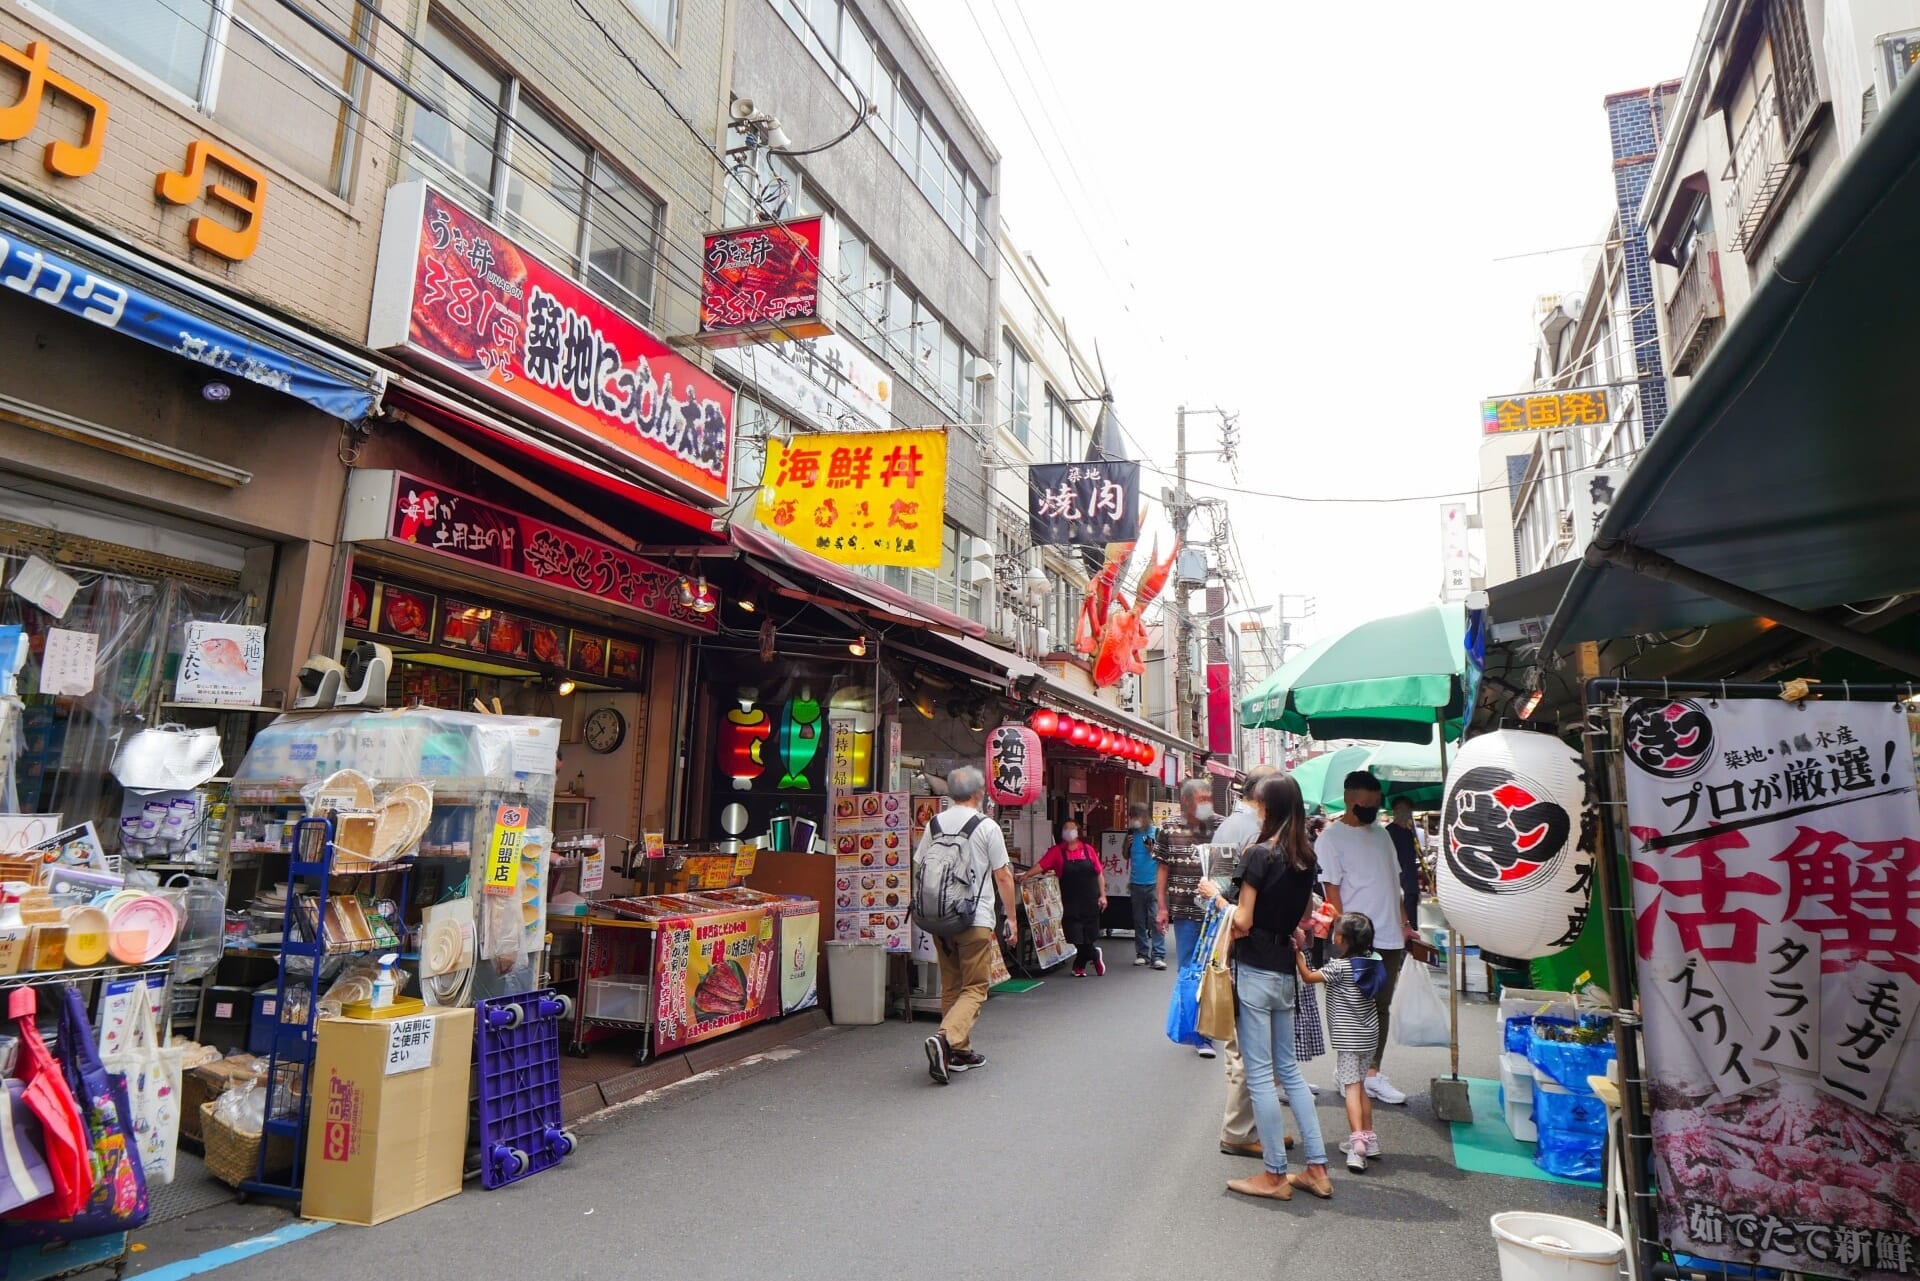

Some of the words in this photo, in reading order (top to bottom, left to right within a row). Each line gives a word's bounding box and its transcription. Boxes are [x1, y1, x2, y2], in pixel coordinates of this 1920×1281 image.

[430, 211, 495, 277] うな丼
[709, 234, 773, 274] うな丼
[0, 236, 128, 328] カヨ
[487, 271, 524, 300] UNADON
[775, 445, 925, 490] 海鮮丼
[1067, 466, 1102, 482] 築地
[400, 489, 460, 522] 毎日が
[1037, 479, 1125, 522] 焼肉
[432, 521, 516, 552] 土用丑の日
[1723, 724, 1859, 771] 築地・水産
[493, 829, 516, 883] 加盟店
[1759, 937, 1810, 1060] タラバ
[391, 1032, 431, 1049] ご使用下
[392, 1018, 432, 1034] 入店前に
[1668, 957, 1752, 1085] ズワイ
[1822, 979, 1902, 1101] 毛ガニ
[389, 1049, 410, 1063] さい
[1686, 1202, 1915, 1274] 茹でたて新鮮
